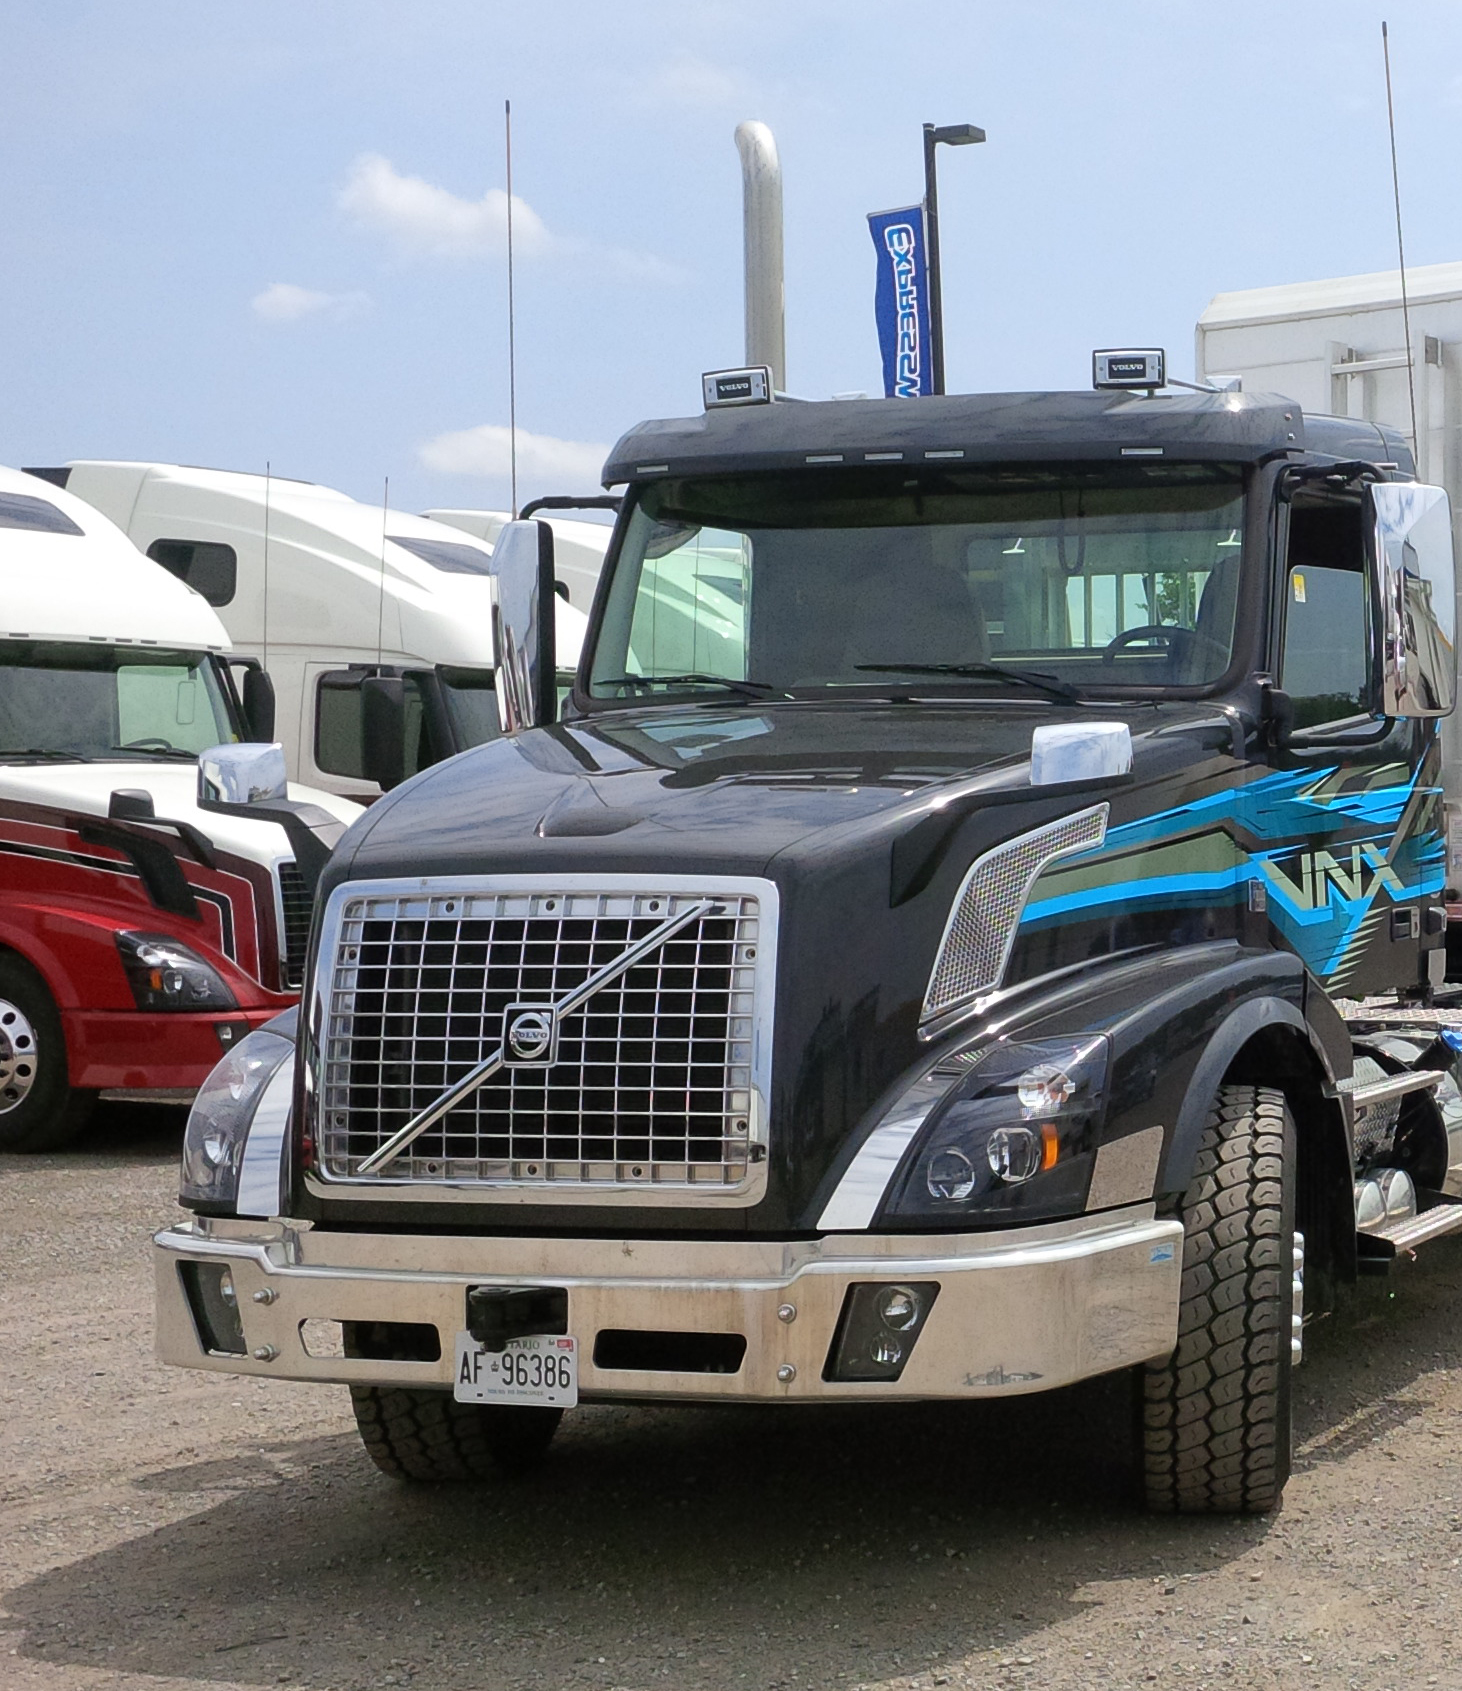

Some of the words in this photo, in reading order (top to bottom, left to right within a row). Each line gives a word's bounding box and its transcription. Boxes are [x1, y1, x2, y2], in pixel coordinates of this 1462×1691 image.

[719, 383, 749, 391] VOLVO
[1260, 842, 1405, 910] VNX
[510, 1030, 548, 1039] VOLVO
[460, 1350, 485, 1384] AF
[501, 1352, 571, 1388] 96386
